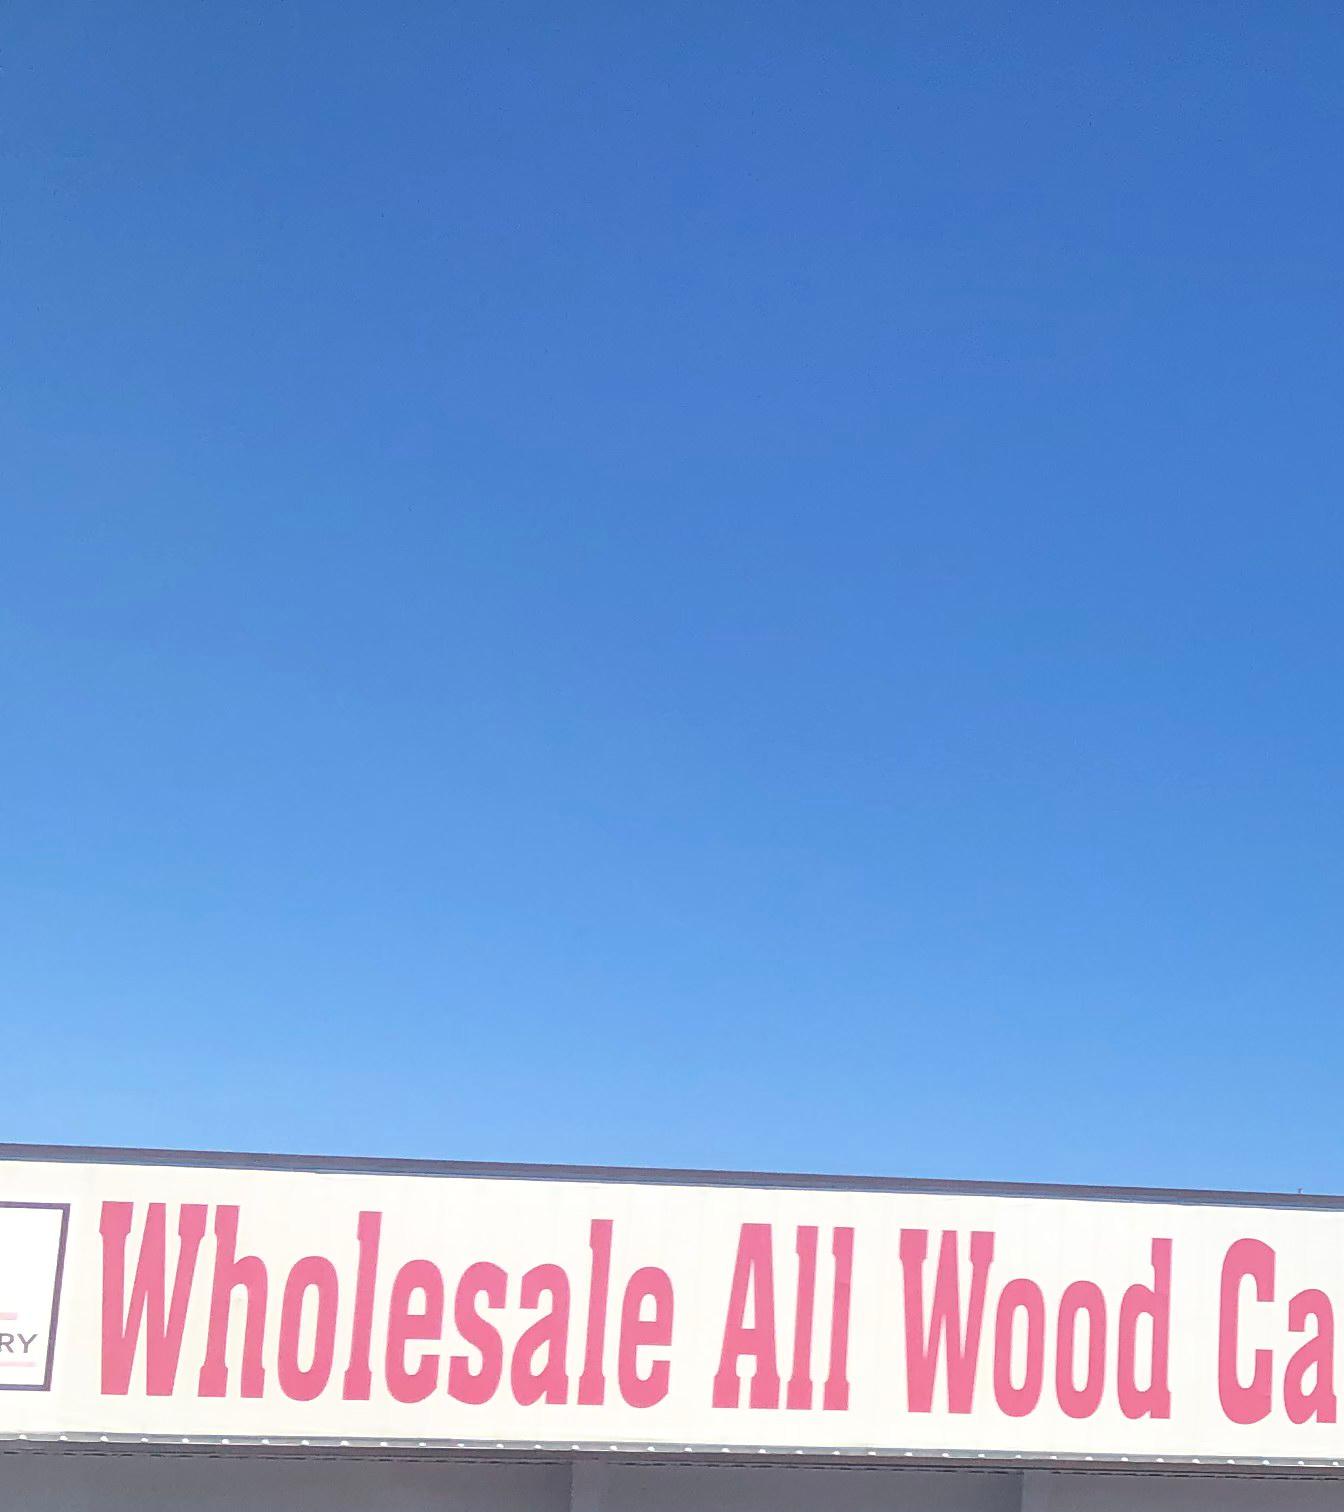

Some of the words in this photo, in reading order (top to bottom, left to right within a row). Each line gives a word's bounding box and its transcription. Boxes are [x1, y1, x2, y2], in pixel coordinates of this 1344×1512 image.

[99, 1201, 674, 1409] Wholesale
[712, 1223, 855, 1411] All
[899, 1228, 1172, 1420] Wood
